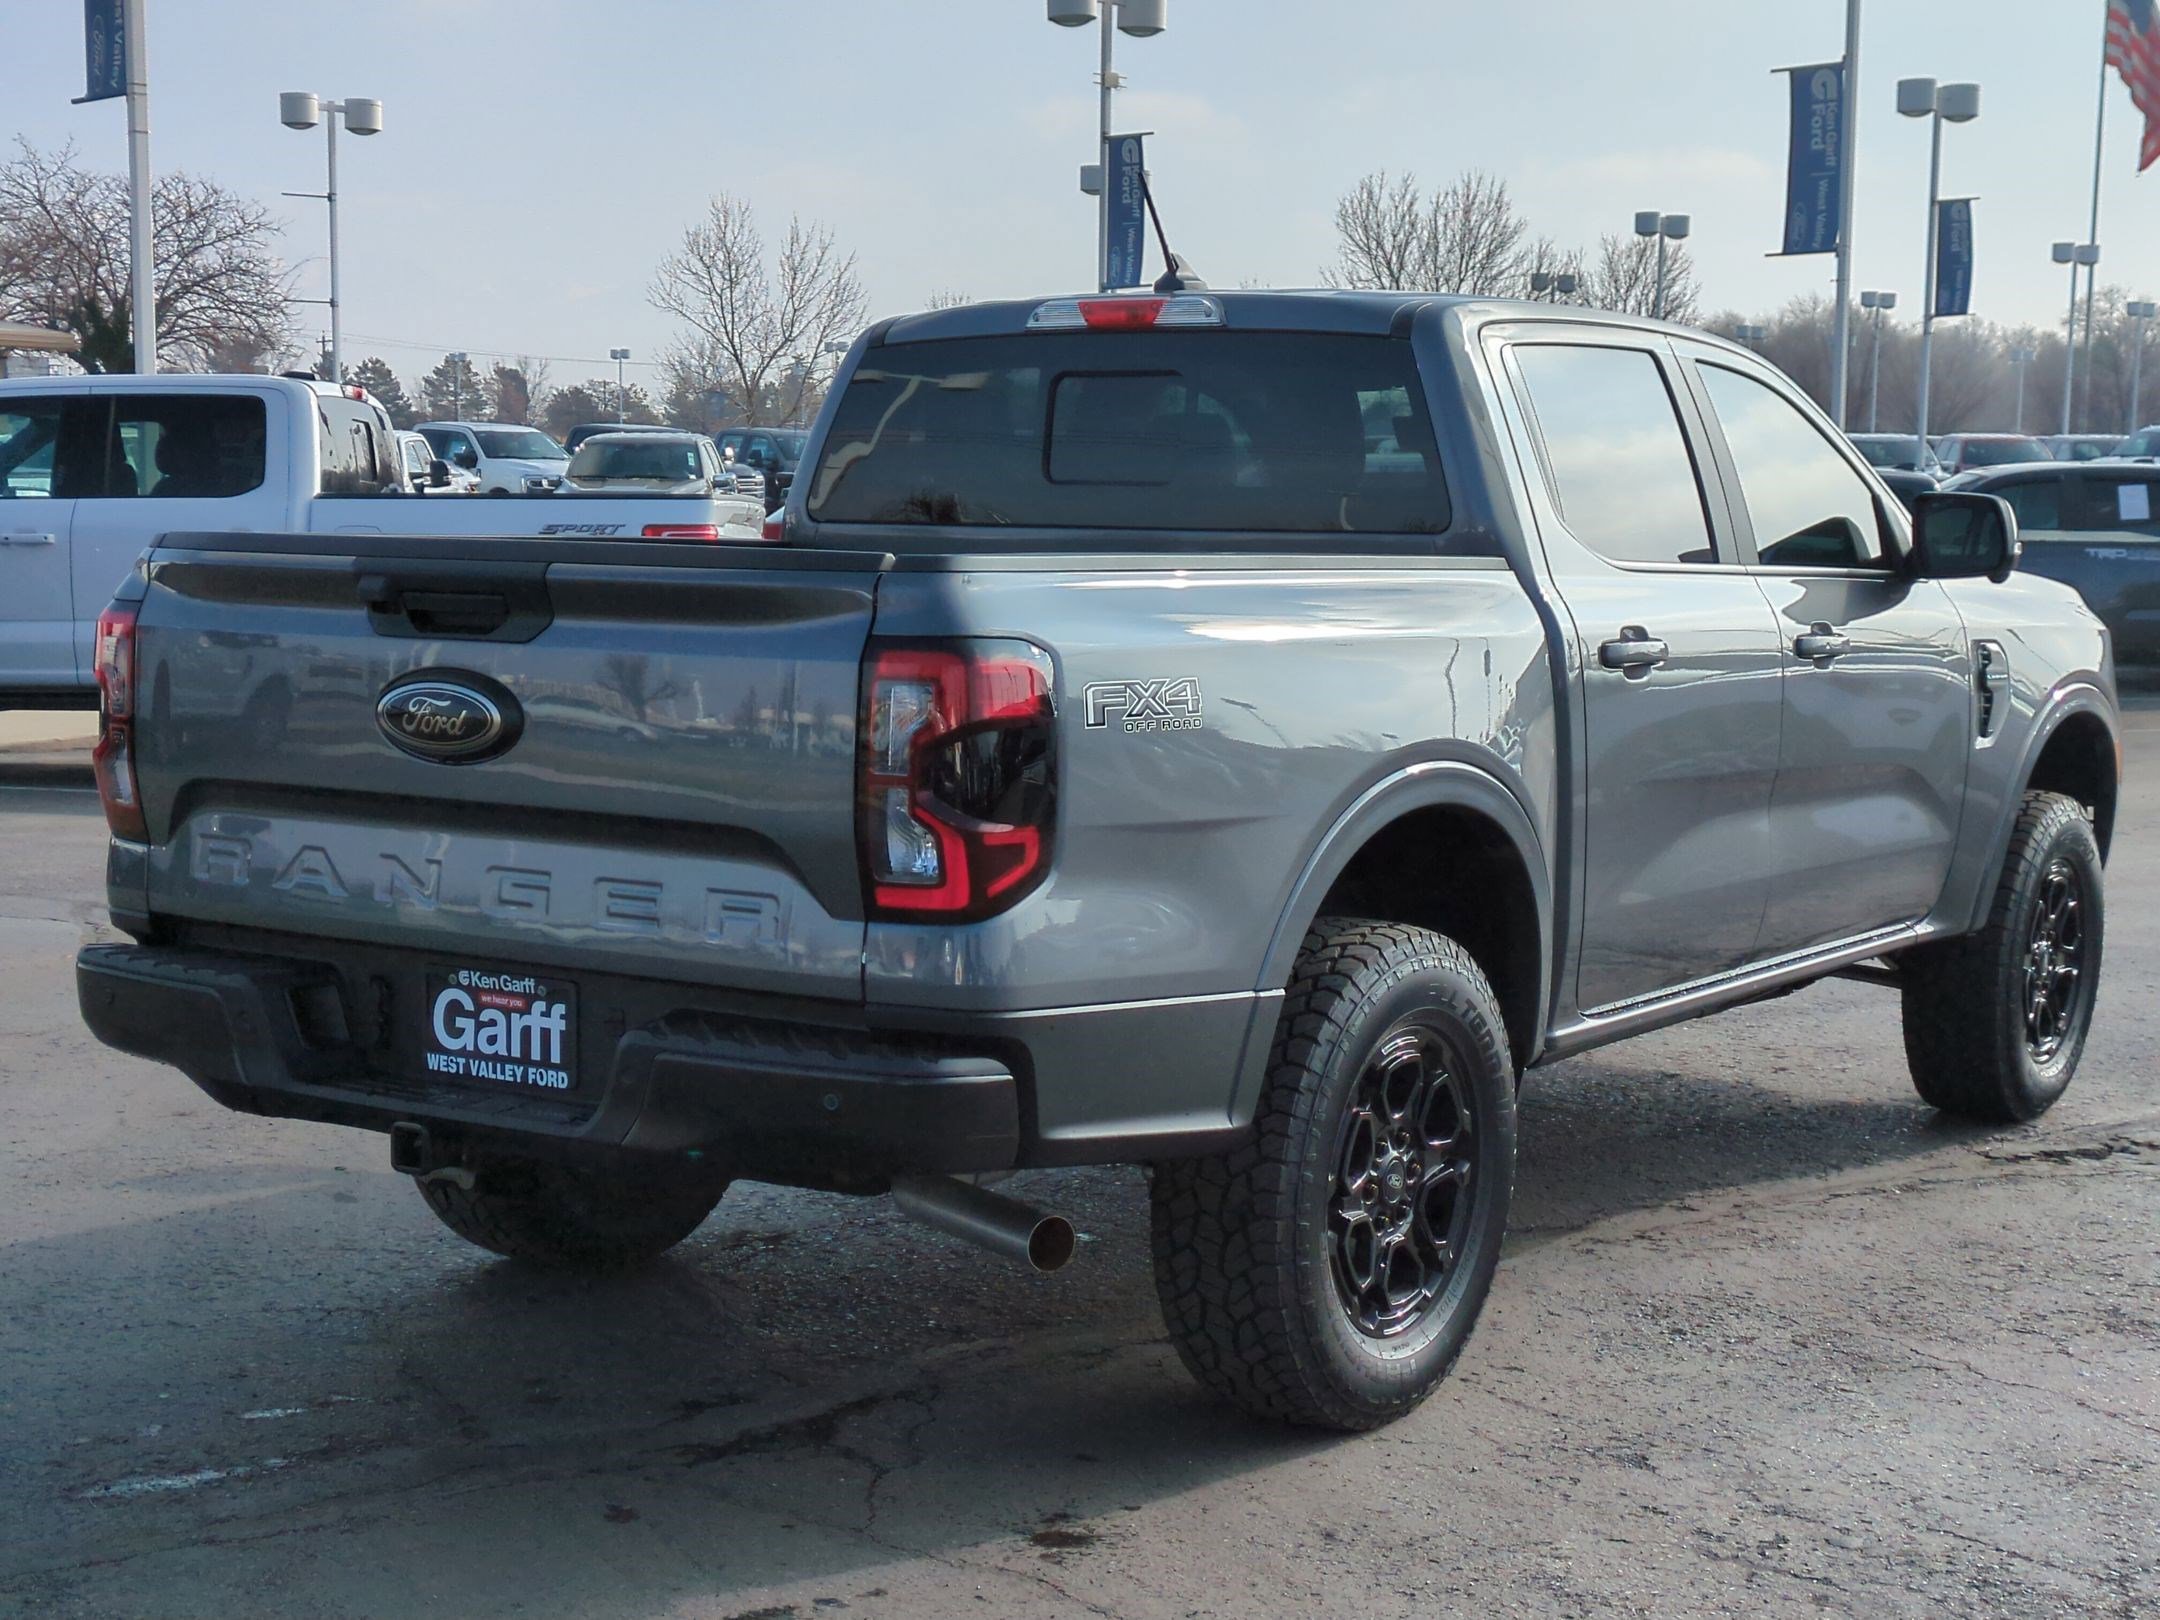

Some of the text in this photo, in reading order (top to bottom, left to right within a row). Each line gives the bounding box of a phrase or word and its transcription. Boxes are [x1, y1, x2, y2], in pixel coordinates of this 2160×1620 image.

[110, 30, 123, 89] Valley
[1810, 103, 1825, 151] Ford
[1824, 101, 1838, 167] Ken Garff
[1121, 166, 1132, 205] Ford
[1131, 189, 1141, 218] Garff
[1812, 179, 1829, 249] West Valley
[1123, 227, 1136, 285] West Valley
[538, 523, 628, 536] SPORT
[402, 696, 468, 736] Ford
[1082, 676, 1203, 730] FX4
[1124, 717, 1203, 734] OFF ROAD
[196, 832, 787, 949] RANGER
[471, 971, 500, 990] Ken
[500, 974, 536, 994] Garff
[433, 987, 567, 1064] Garff
[427, 1052, 569, 1090] WEST VALLEY FORD
